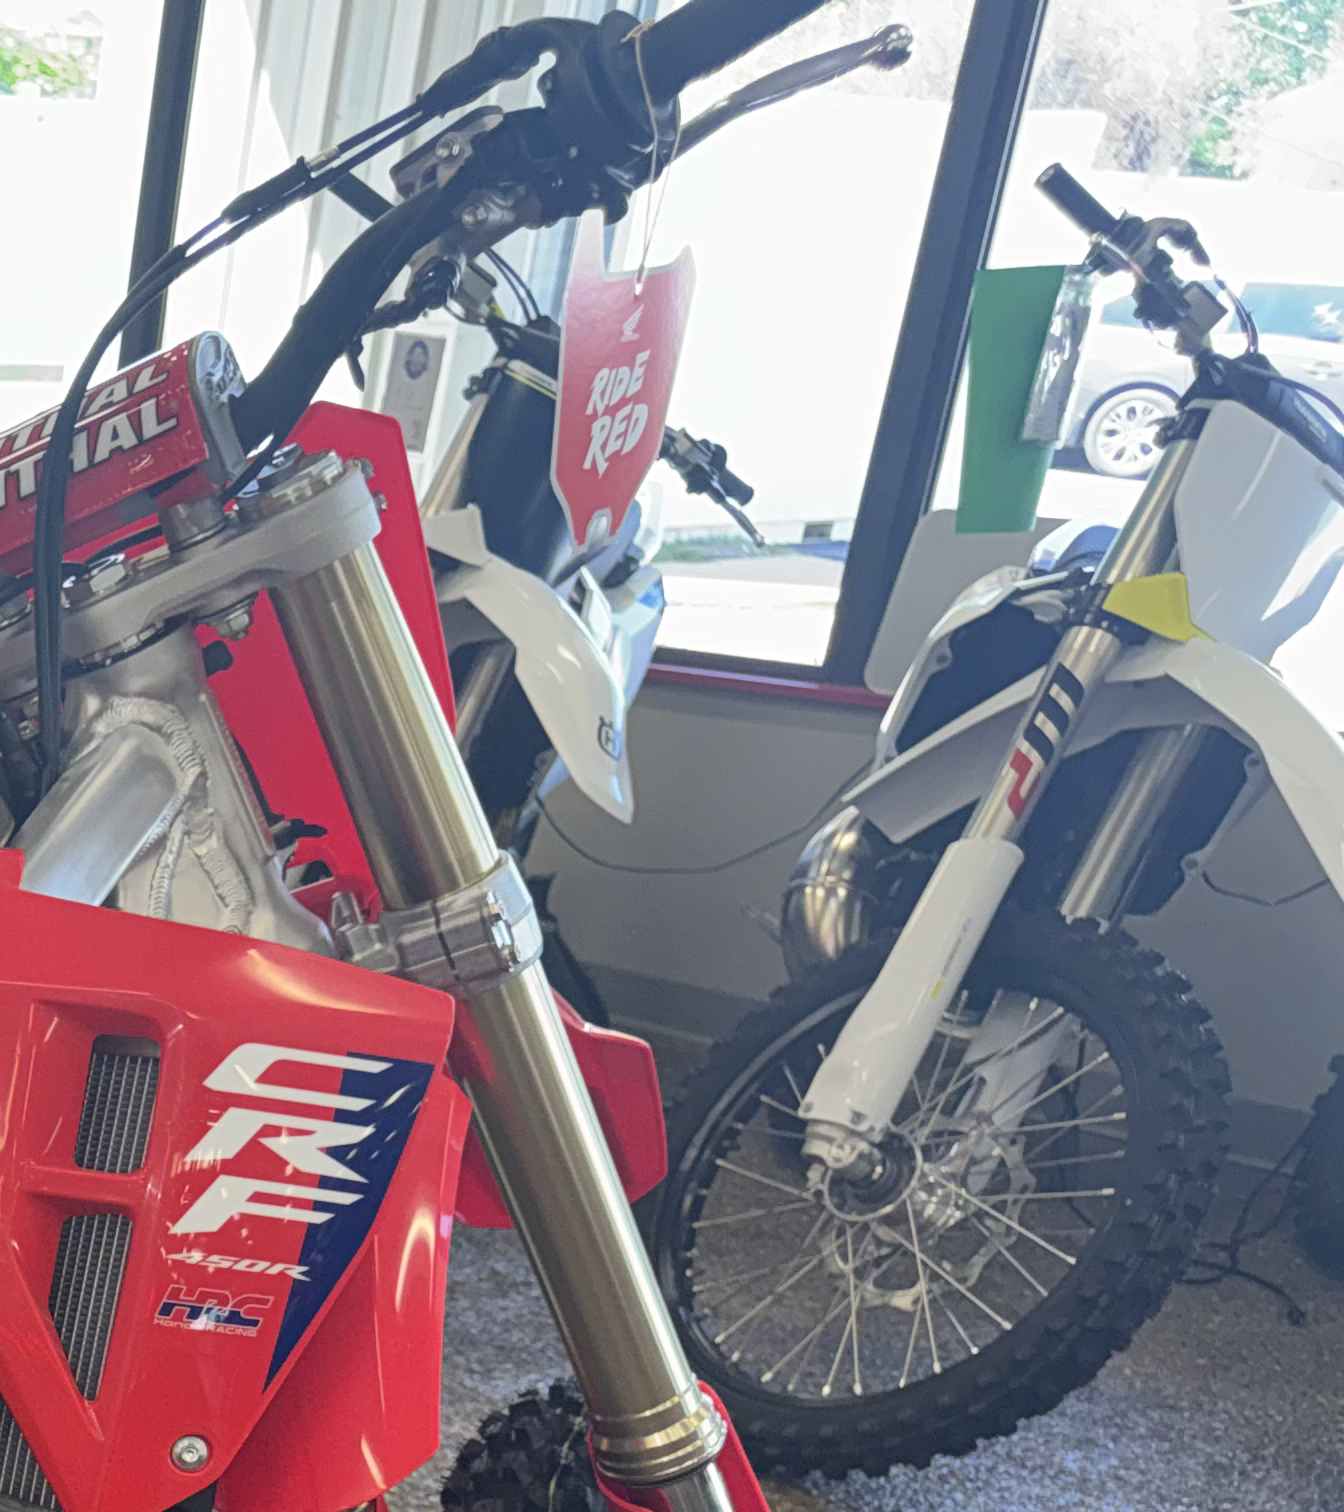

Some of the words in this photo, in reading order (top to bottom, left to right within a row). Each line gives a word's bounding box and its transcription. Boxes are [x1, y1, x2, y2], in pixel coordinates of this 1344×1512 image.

[585, 348, 651, 418] RIDE
[582, 401, 649, 480] RED
[168, 1042, 394, 1234] CRF
[167, 1251, 312, 1282] 450R
[154, 1284, 275, 1329] HRC
